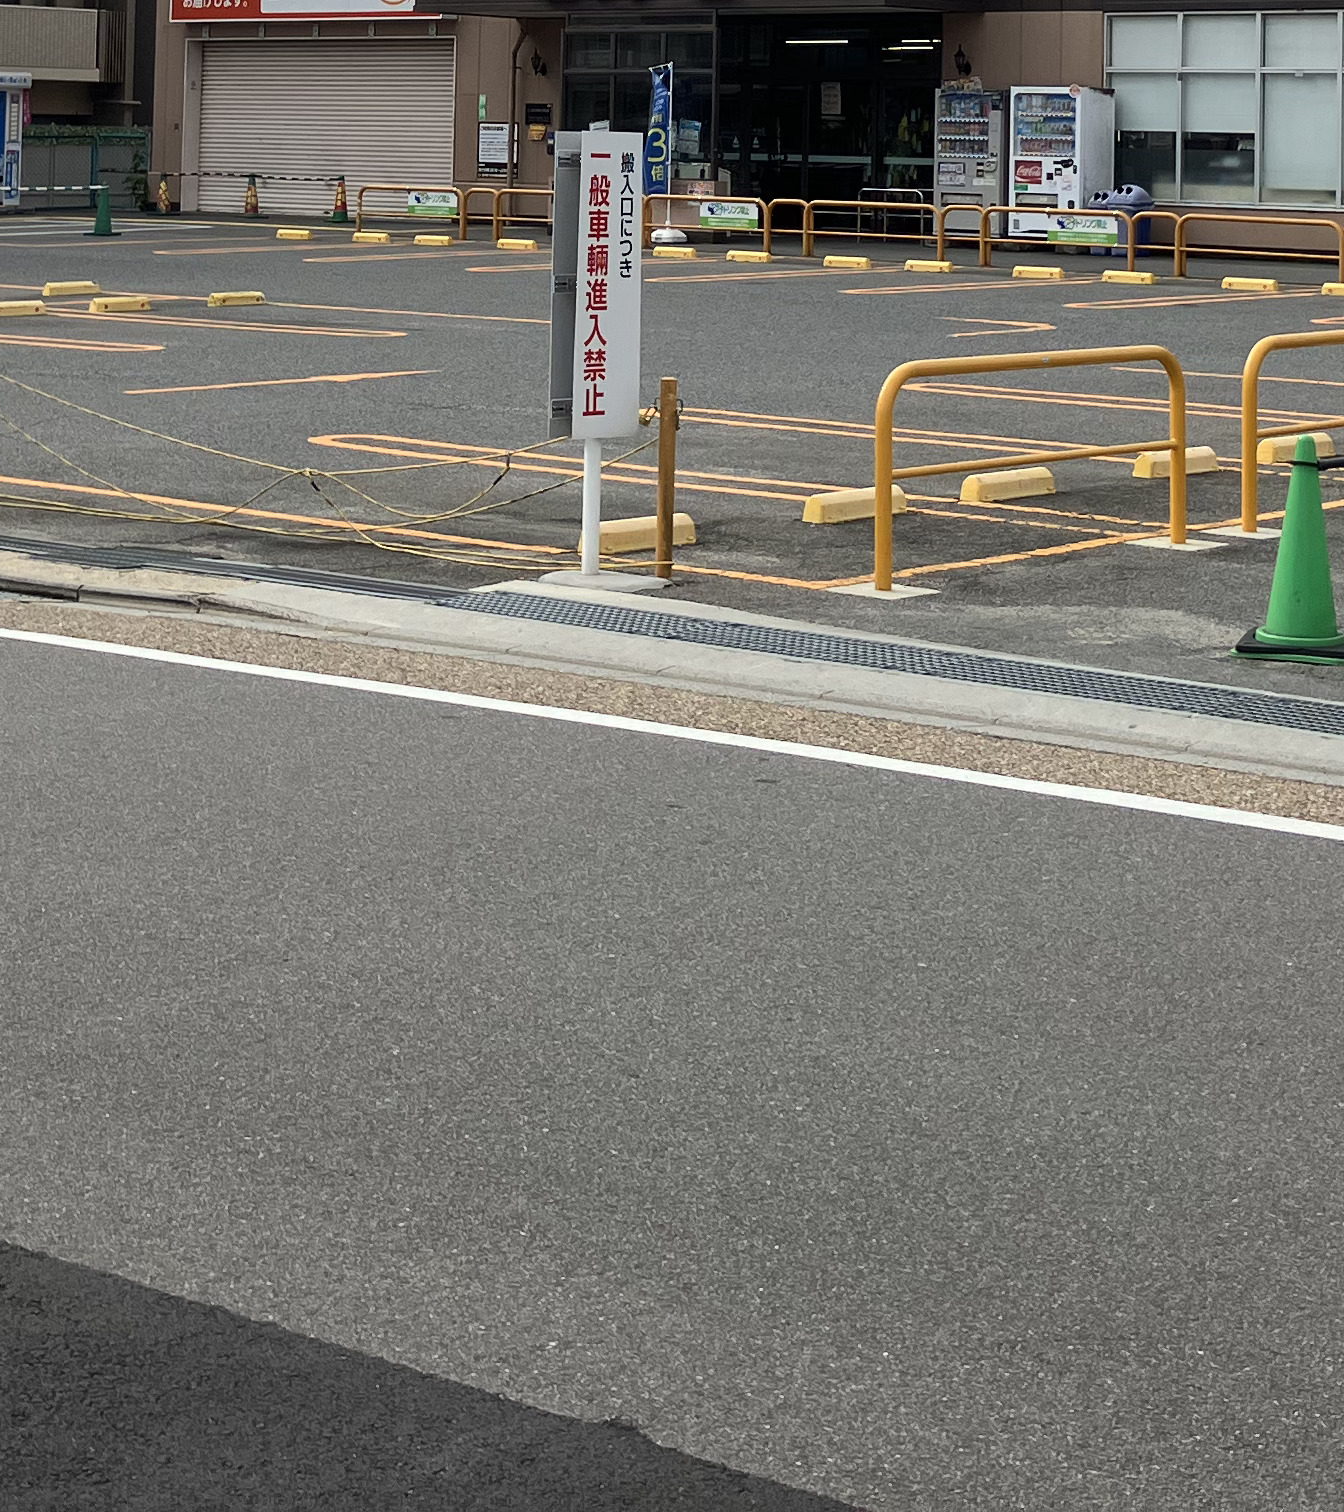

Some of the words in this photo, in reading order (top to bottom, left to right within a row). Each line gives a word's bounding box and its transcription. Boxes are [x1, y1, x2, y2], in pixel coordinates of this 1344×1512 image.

[582, 151, 611, 418] 一般車輛進入禁止
[619, 151, 636, 279] 搬入口につき
